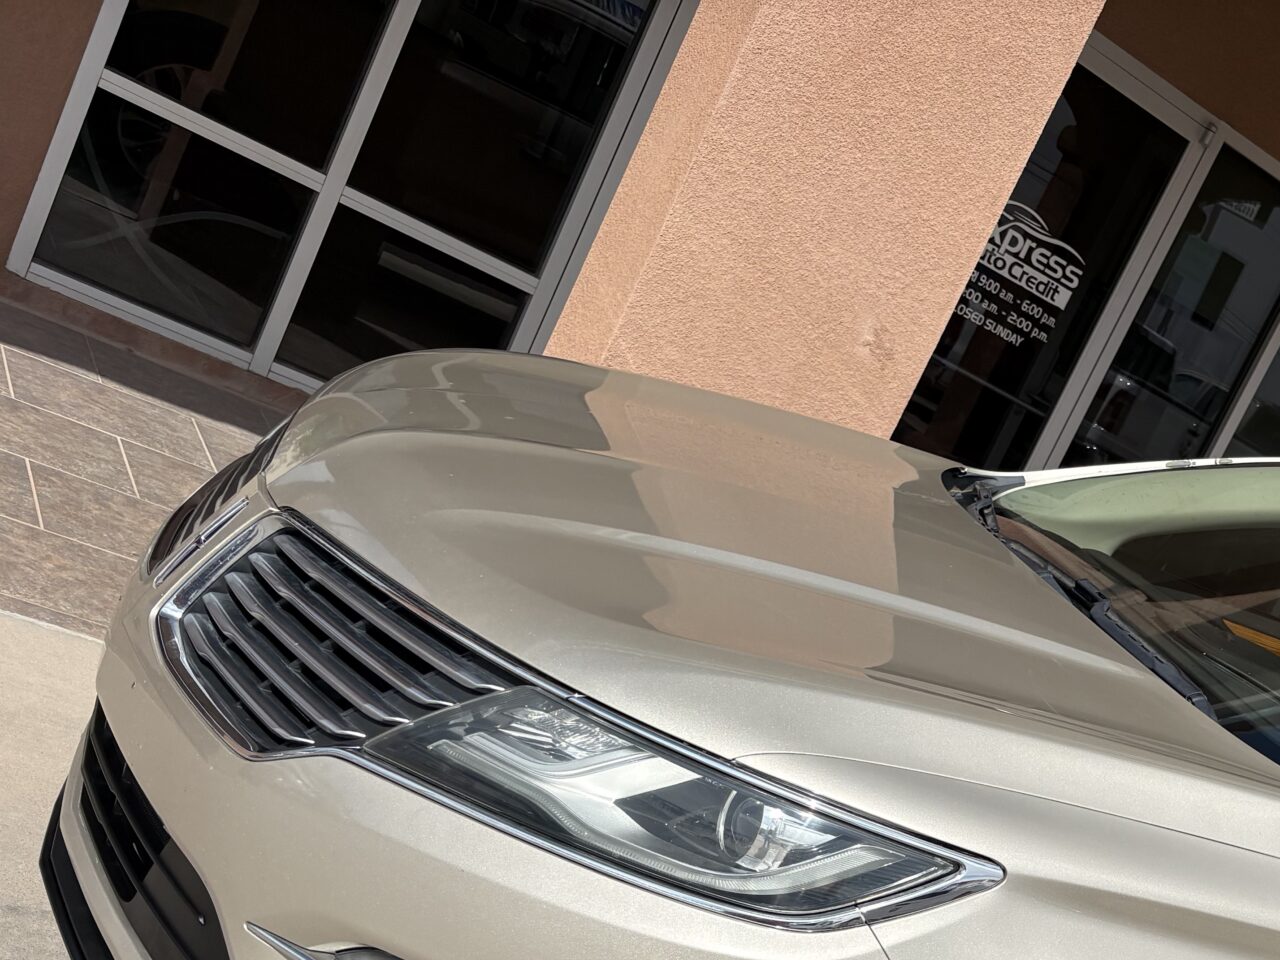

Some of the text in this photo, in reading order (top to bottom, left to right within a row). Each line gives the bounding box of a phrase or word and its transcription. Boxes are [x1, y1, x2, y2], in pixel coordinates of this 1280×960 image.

[989, 224, 1083, 289] xpress
[1008, 260, 1060, 302] Credit
[954, 304, 1025, 347] OSED SUNDAY
[963, 288, 982, 304] :00
[982, 299, 999, 315] a.m.
[1007, 312, 1032, 332] 2:00
[1031, 325, 1048, 343] p.m.
[978, 275, 1000, 295] 9:00
[1021, 300, 1043, 319] 6:00
[1041, 312, 1056, 328] p.m.
